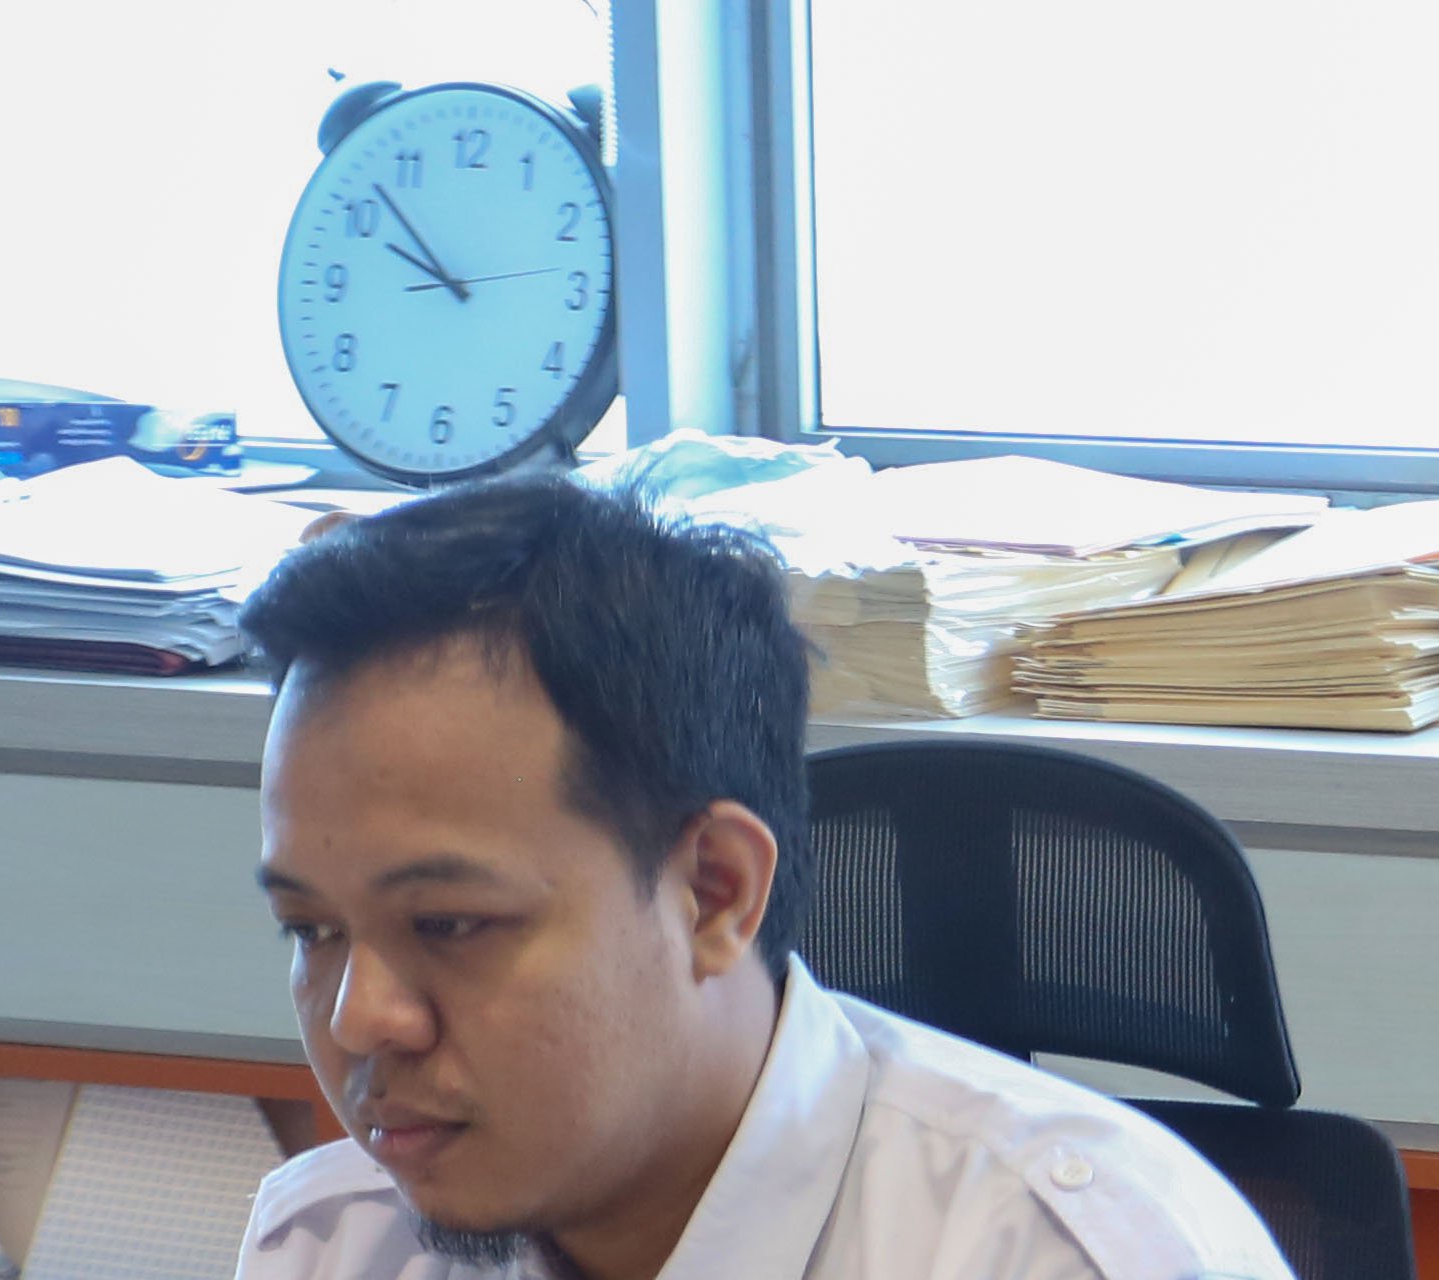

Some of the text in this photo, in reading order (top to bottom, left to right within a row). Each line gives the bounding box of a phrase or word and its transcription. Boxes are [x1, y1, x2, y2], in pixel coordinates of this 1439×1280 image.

[453, 129, 492, 169] 12
[395, 149, 424, 189] 11
[518, 153, 536, 191] 1
[342, 200, 381, 238] 10
[557, 202, 581, 242] 2
[324, 263, 348, 302] 9
[564, 272, 589, 311] 3
[332, 333, 357, 373] 8
[541, 341, 566, 378] 4
[378, 383, 401, 421] 7
[493, 388, 517, 427] 5
[431, 405, 454, 444] 6
